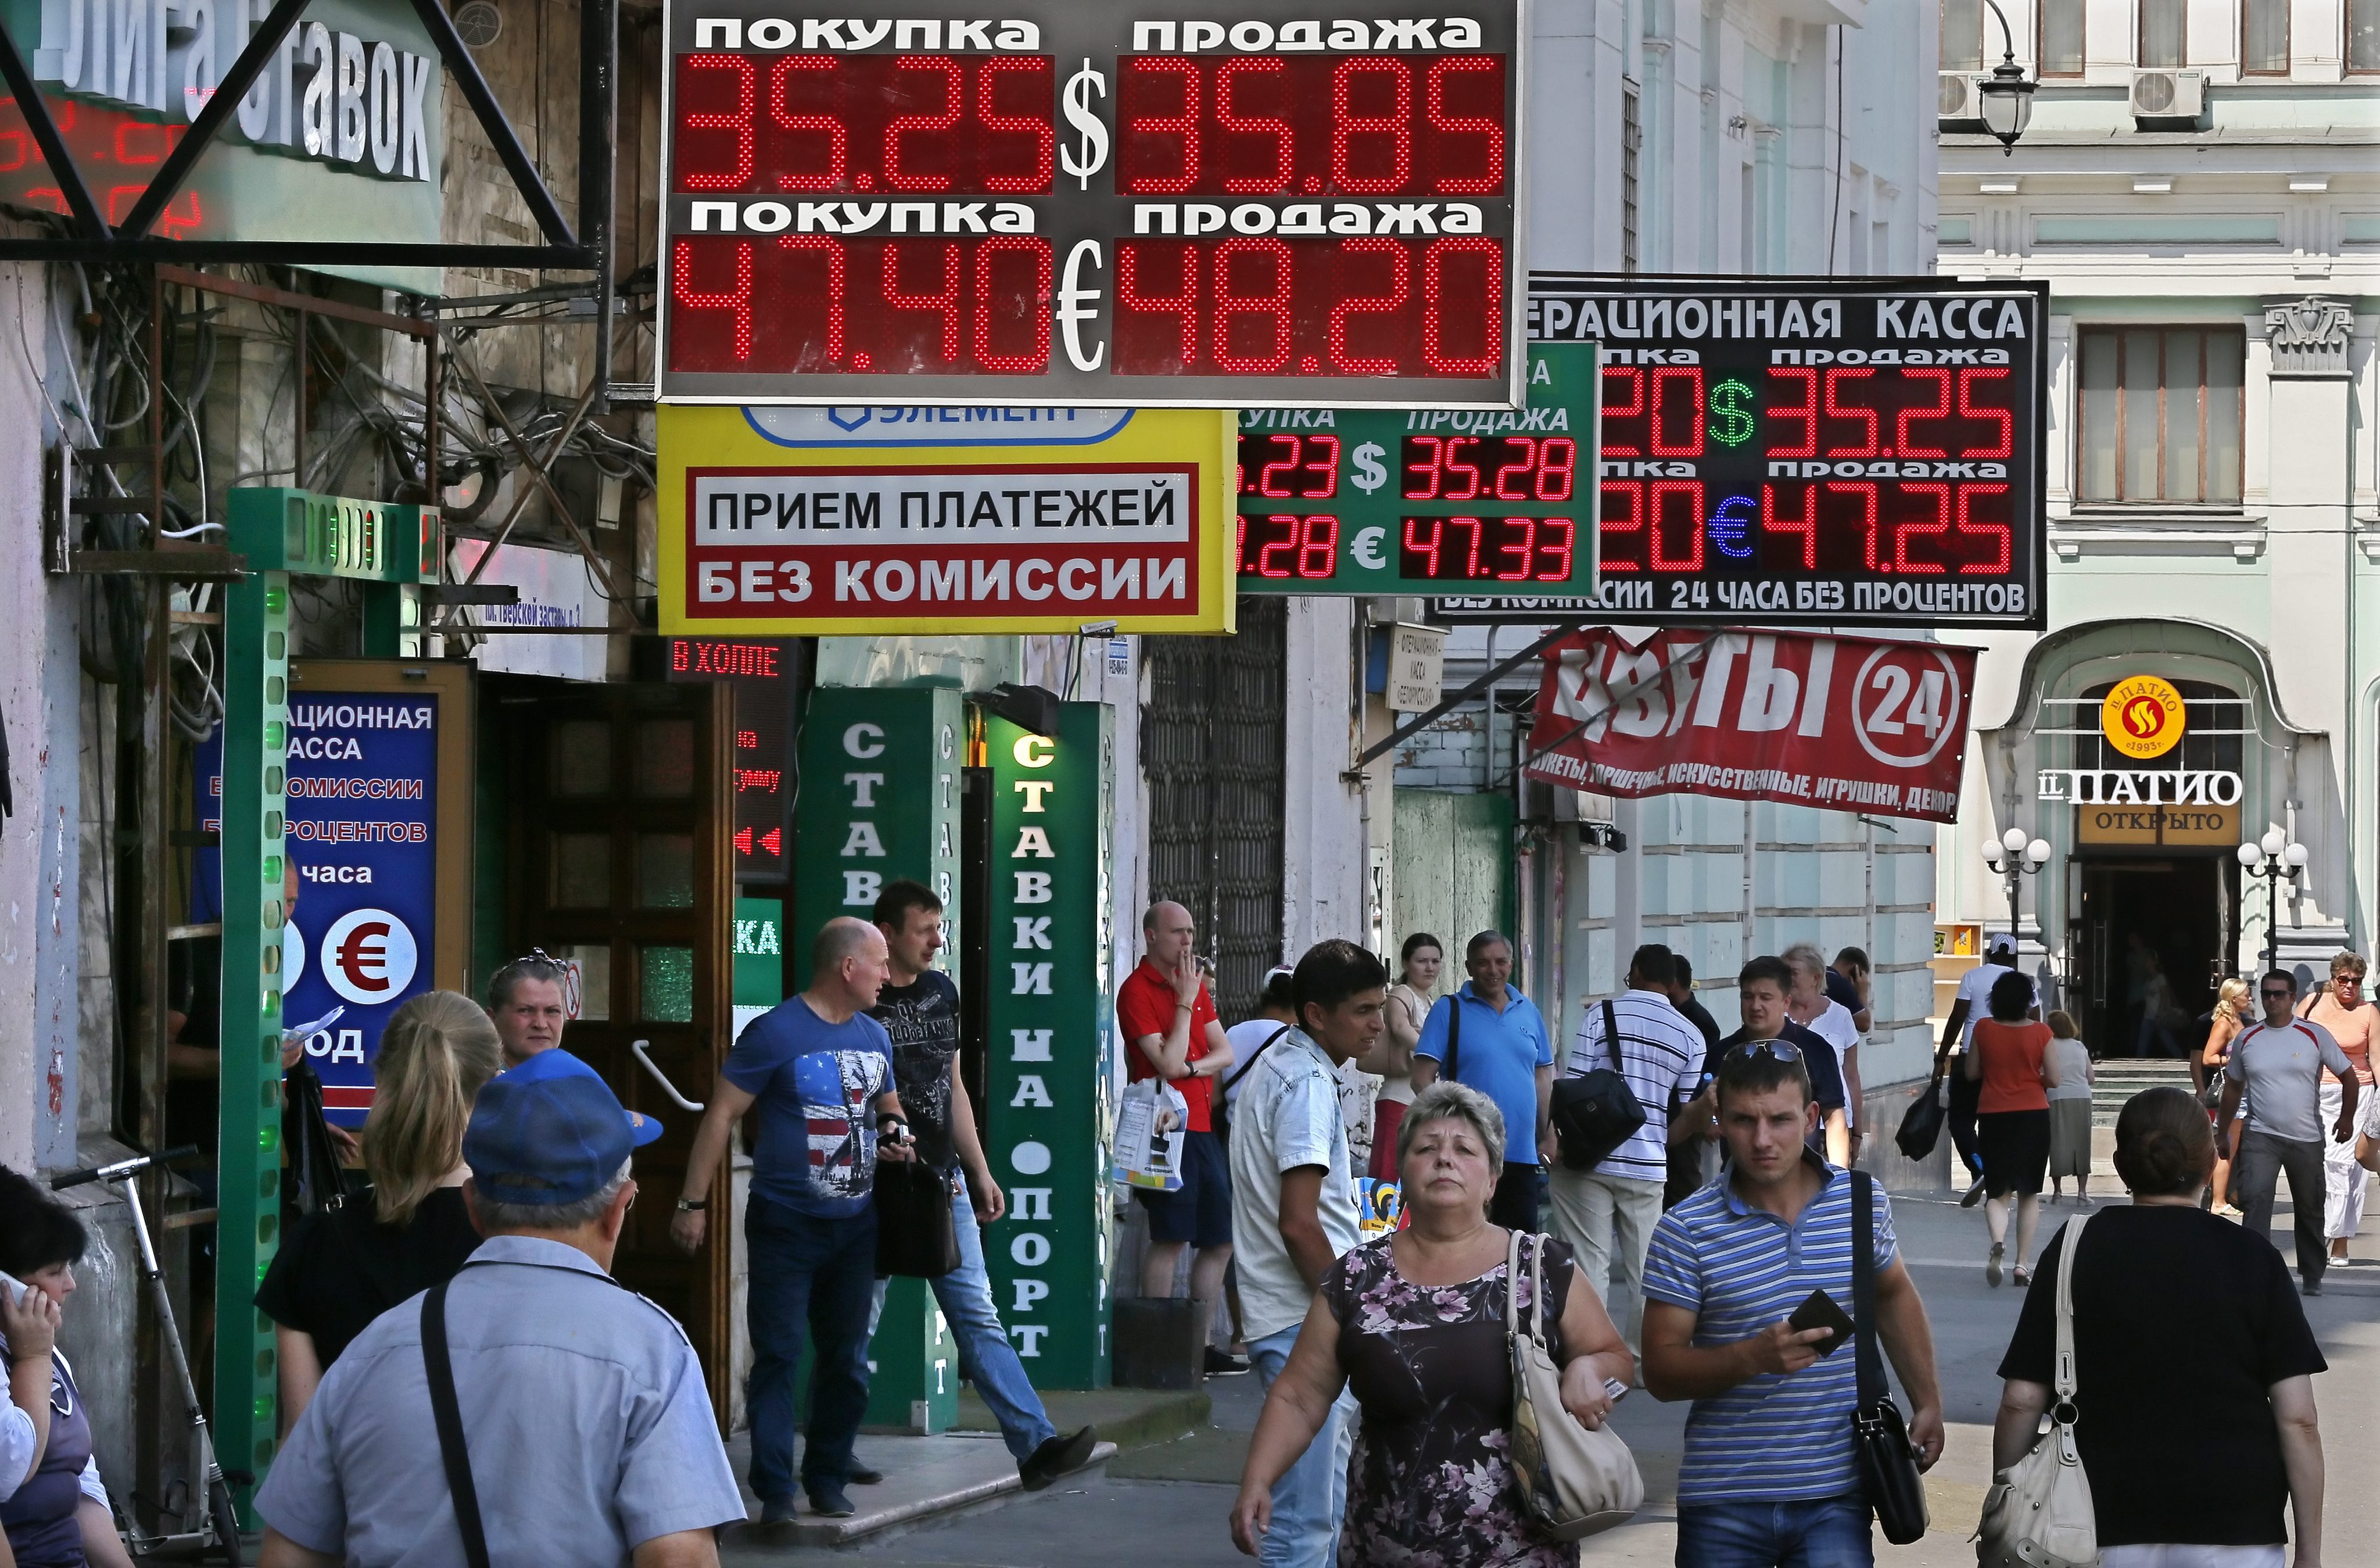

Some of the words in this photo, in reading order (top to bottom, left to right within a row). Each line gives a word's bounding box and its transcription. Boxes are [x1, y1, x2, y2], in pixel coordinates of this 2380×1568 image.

[686, 55, 1054, 190] 35.25
[1060, 56, 1109, 191] $
[1132, 56, 1504, 193] 35.85
[675, 235, 1053, 372] 47.40
[1055, 239, 1105, 372] €
[1120, 237, 1501, 373] 48.20
[1526, 299, 1841, 339] ЕРАЦИОННАЯ
[1876, 299, 2026, 339] КАССА
[1407, 408, 1569, 435] ПРОДАЖА
[1709, 378, 1755, 447] $
[1765, 366, 2013, 459] 35.25
[1236, 435, 1340, 498] .23
[1350, 441, 1388, 495] $
[1404, 436, 1576, 502] 35.28
[709, 492, 881, 531] ПРИЕМ
[899, 479, 1175, 529] ПЛАТЕЖЕЙ
[1708, 495, 1756, 557] €
[1762, 482, 2010, 574] 47.25
[1235, 514, 1339, 578] .28
[1350, 526, 1386, 570] €
[1404, 517, 1575, 581] 47.33
[698, 560, 812, 603] БЕЗ
[834, 557, 1186, 602] КОМИССИИ
[1671, 581, 1709, 609] 24
[1716, 581, 1786, 610] ЧАСА
[1797, 581, 1844, 611] БЕЗ
[1854, 582, 2025, 613] ПРОЦЕНТОВ
[673, 640, 689, 671] В
[285, 705, 432, 731] АЦИОННАЯ
[1866, 664, 1945, 739] 24
[2119, 682, 2177, 712] ПАТИО
[286, 737, 363, 760] АССА
[737, 731, 757, 747] на
[285, 777, 423, 800] ОМИССИИ
[1667, 762, 1811, 799] ИСКУССТВЕННЫЕ,
[1815, 776, 1902, 807] ИГРУШКИ,
[1905, 787, 1956, 814] ДЕКОР
[2038, 775, 2064, 795] IL
[2068, 771, 2243, 806] ПАТИО
[285, 819, 427, 844] РОЦЕНТОВ
[2095, 812, 2224, 830] ОТКРЫТО
[302, 865, 372, 883] часа
[1010, 735, 1055, 996] СТАВКИ
[336, 921, 391, 991] €
[304, 1029, 364, 1064] ОД
[1010, 1029, 1053, 1108] НА
